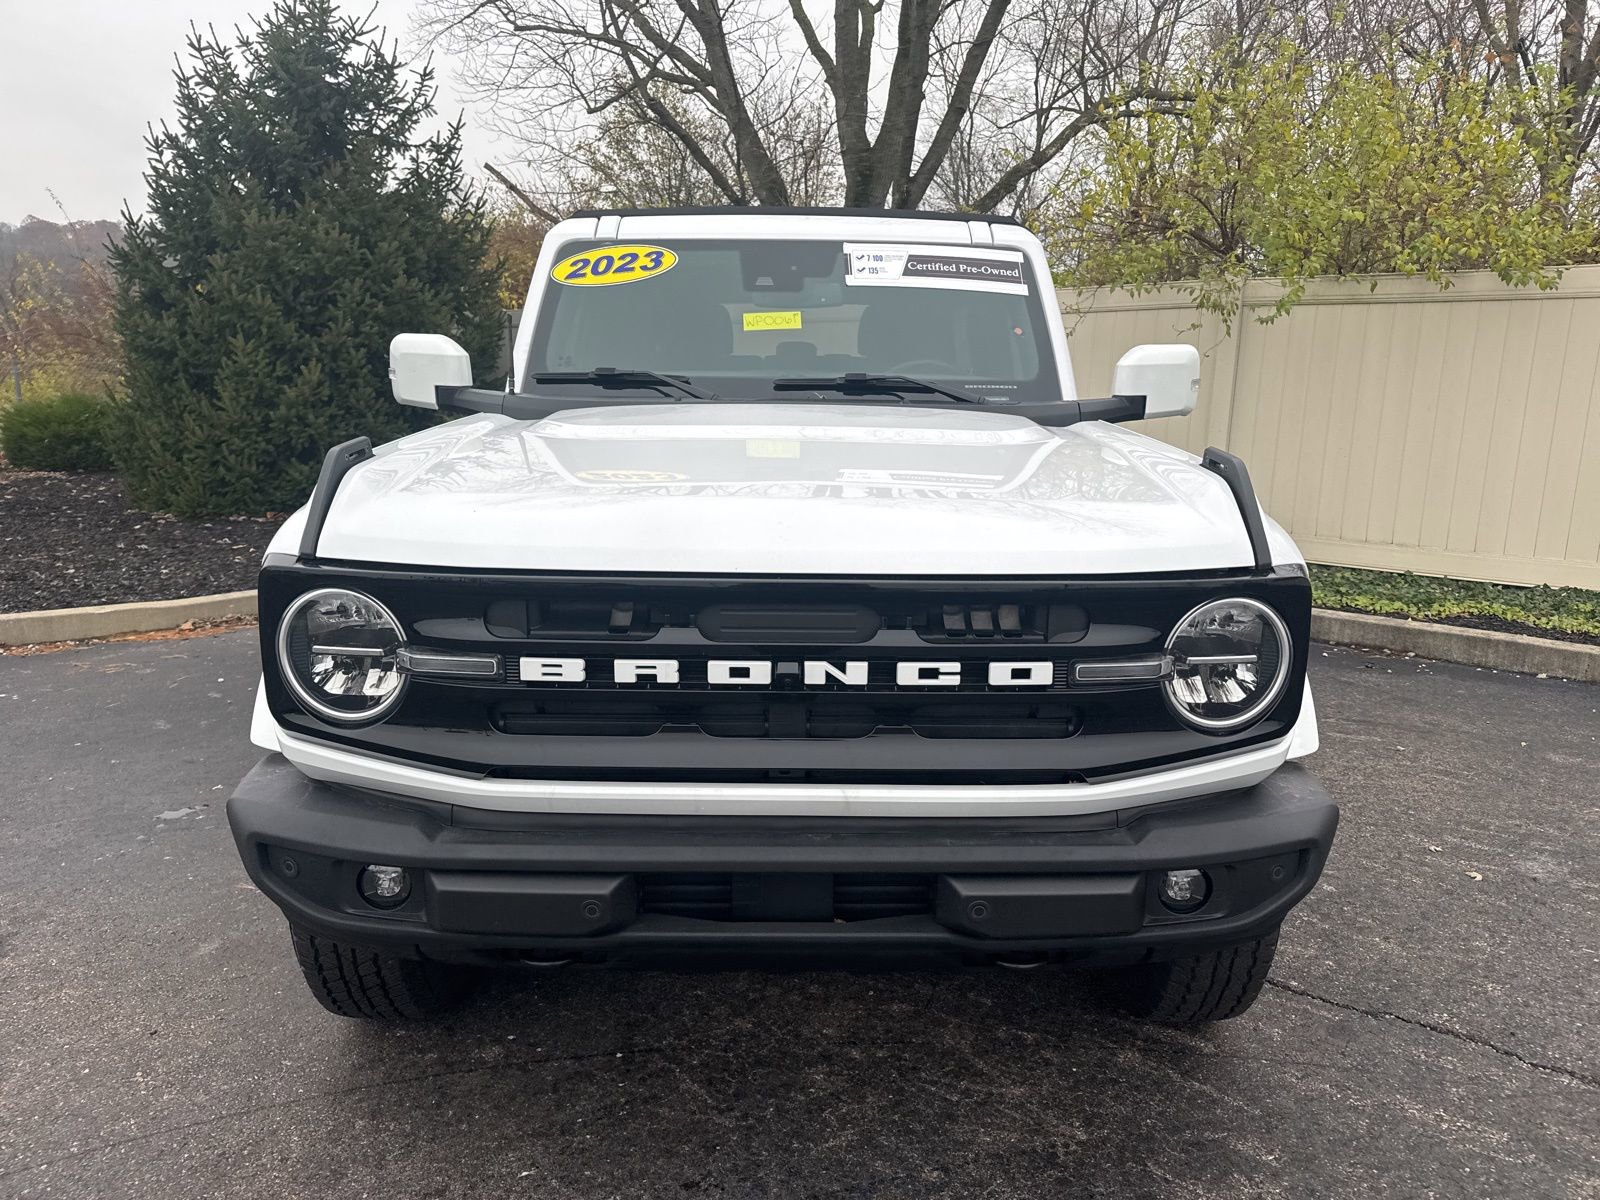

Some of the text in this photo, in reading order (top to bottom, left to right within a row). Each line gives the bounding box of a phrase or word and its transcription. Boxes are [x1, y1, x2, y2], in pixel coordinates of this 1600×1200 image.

[564, 250, 665, 280] 2023
[907, 261, 1019, 277] Certified Pre-Owned
[519, 656, 1054, 686] BRONCO
